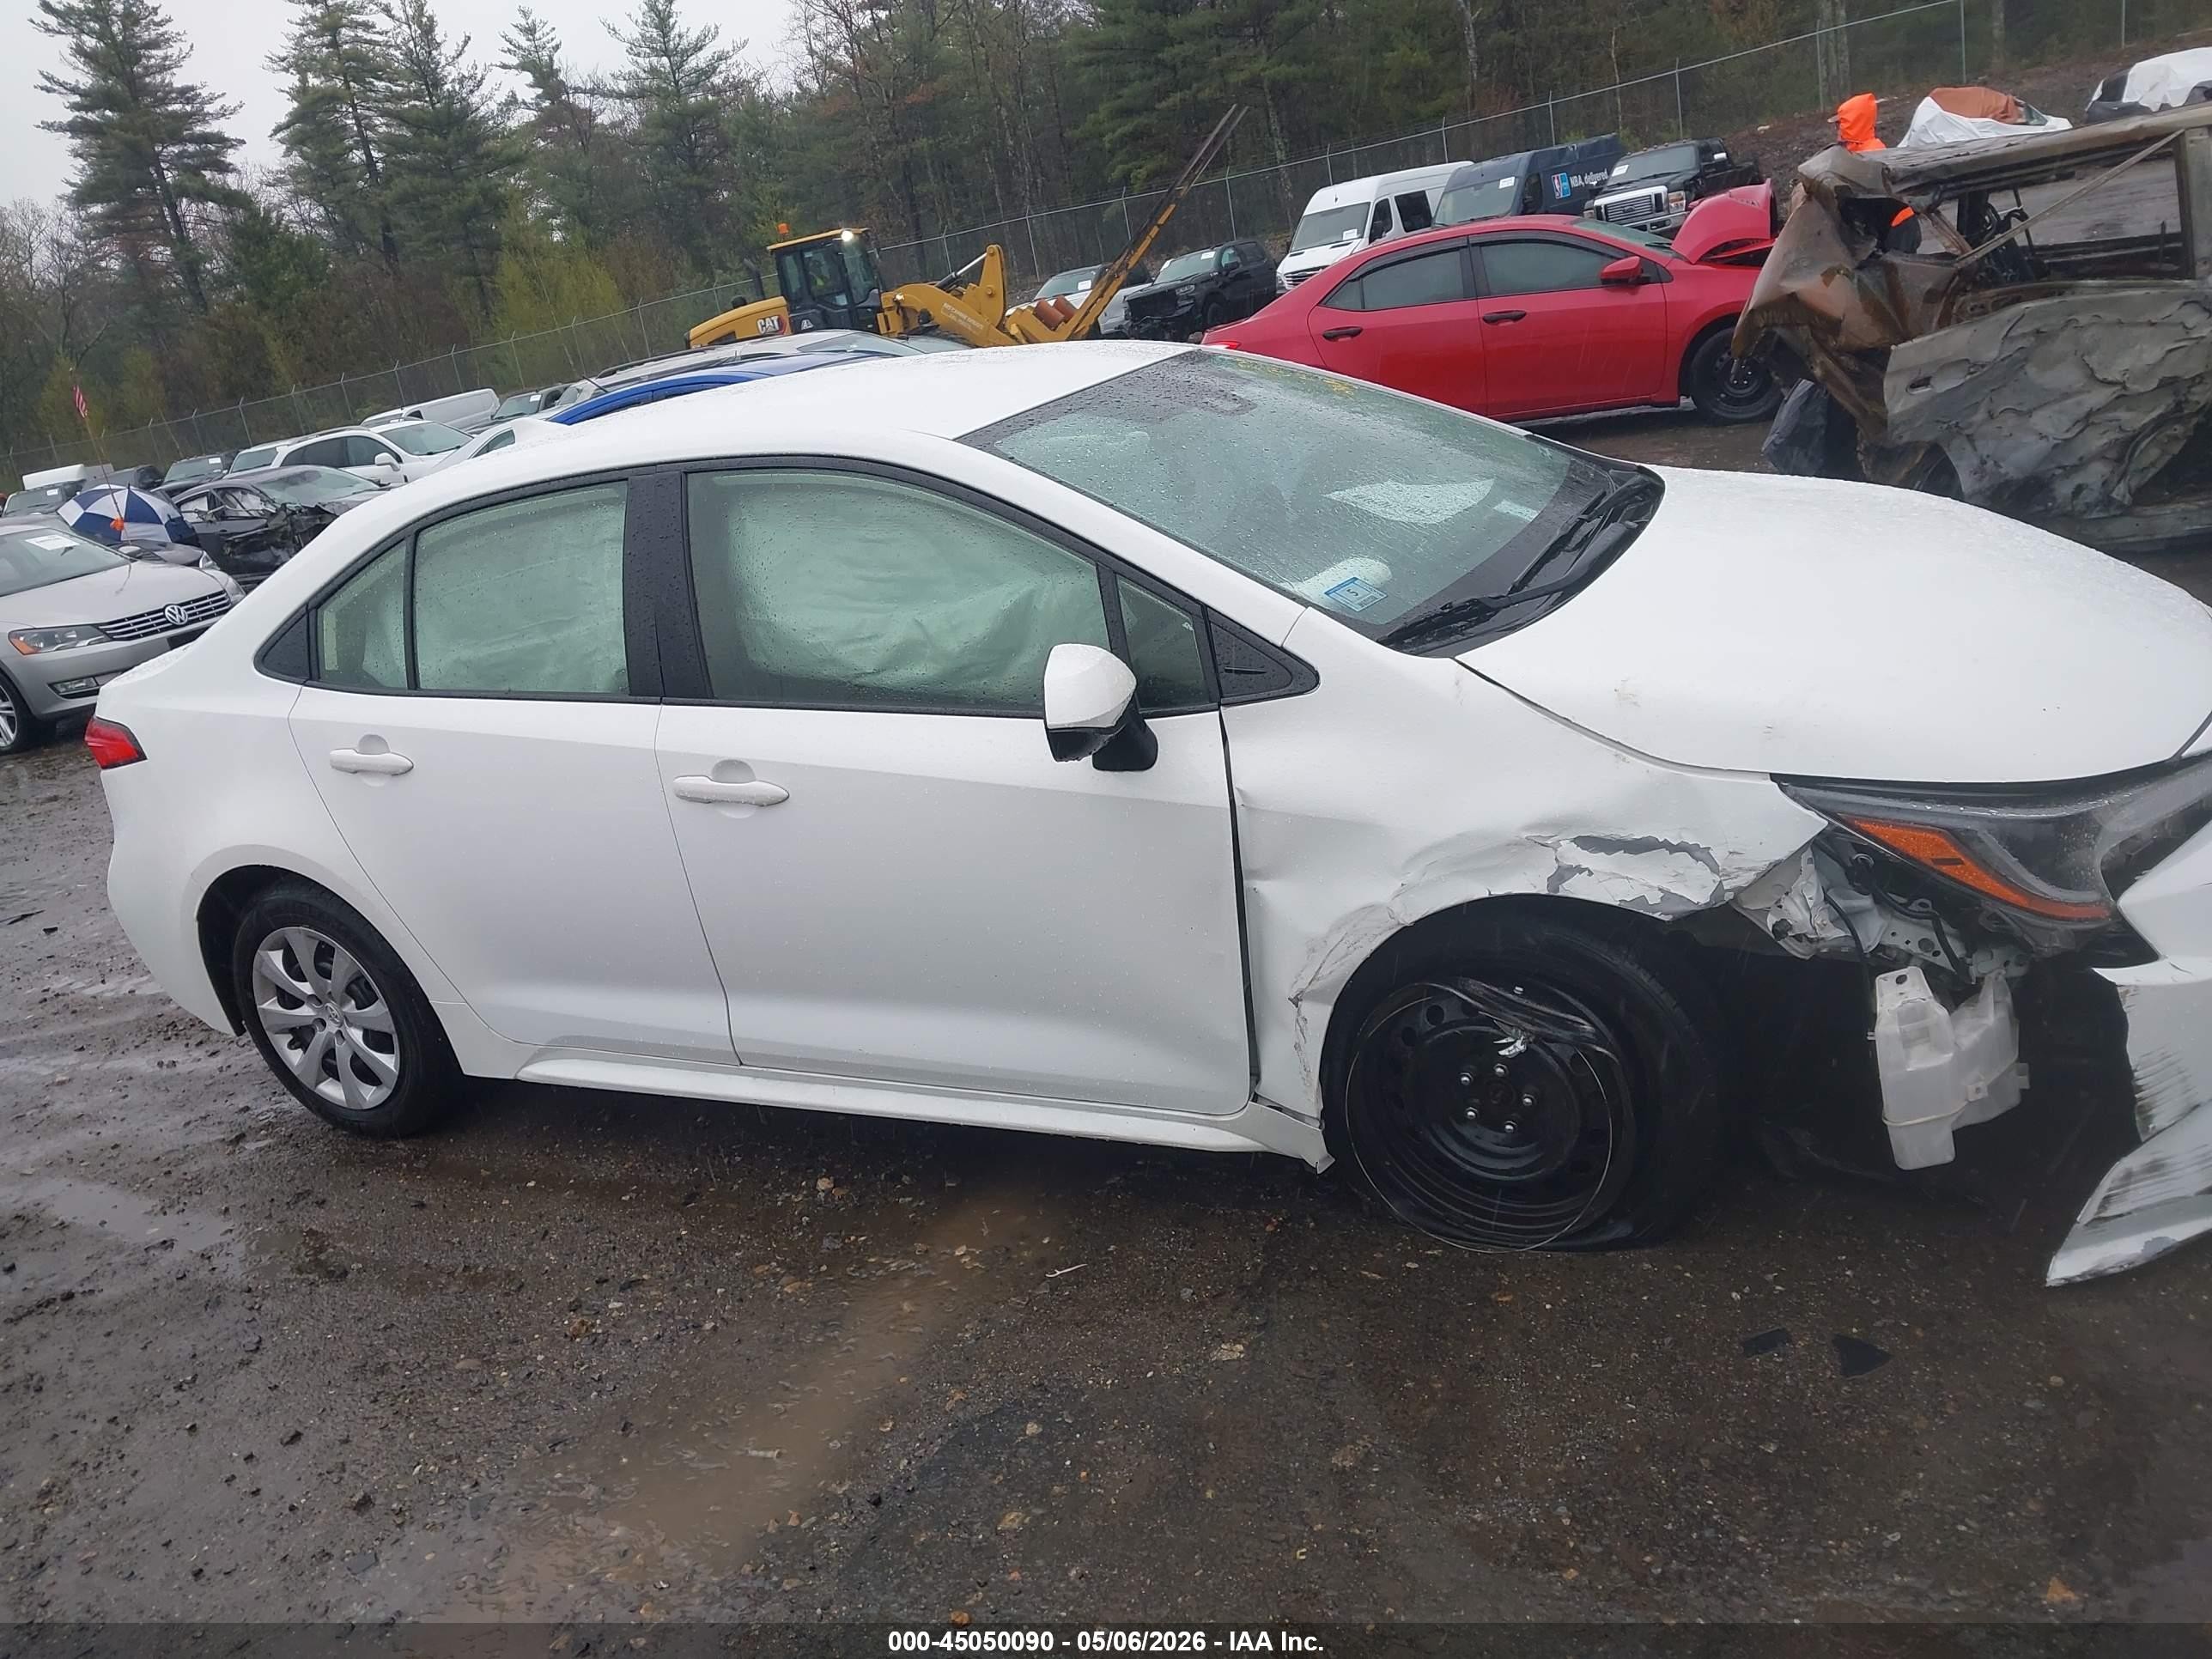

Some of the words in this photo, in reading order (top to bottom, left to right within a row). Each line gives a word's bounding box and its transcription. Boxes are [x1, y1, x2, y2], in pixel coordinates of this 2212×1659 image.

[1570, 174, 1585, 188] NBA,
[1585, 168, 1609, 184] delivered
[757, 315, 780, 334] CAT
